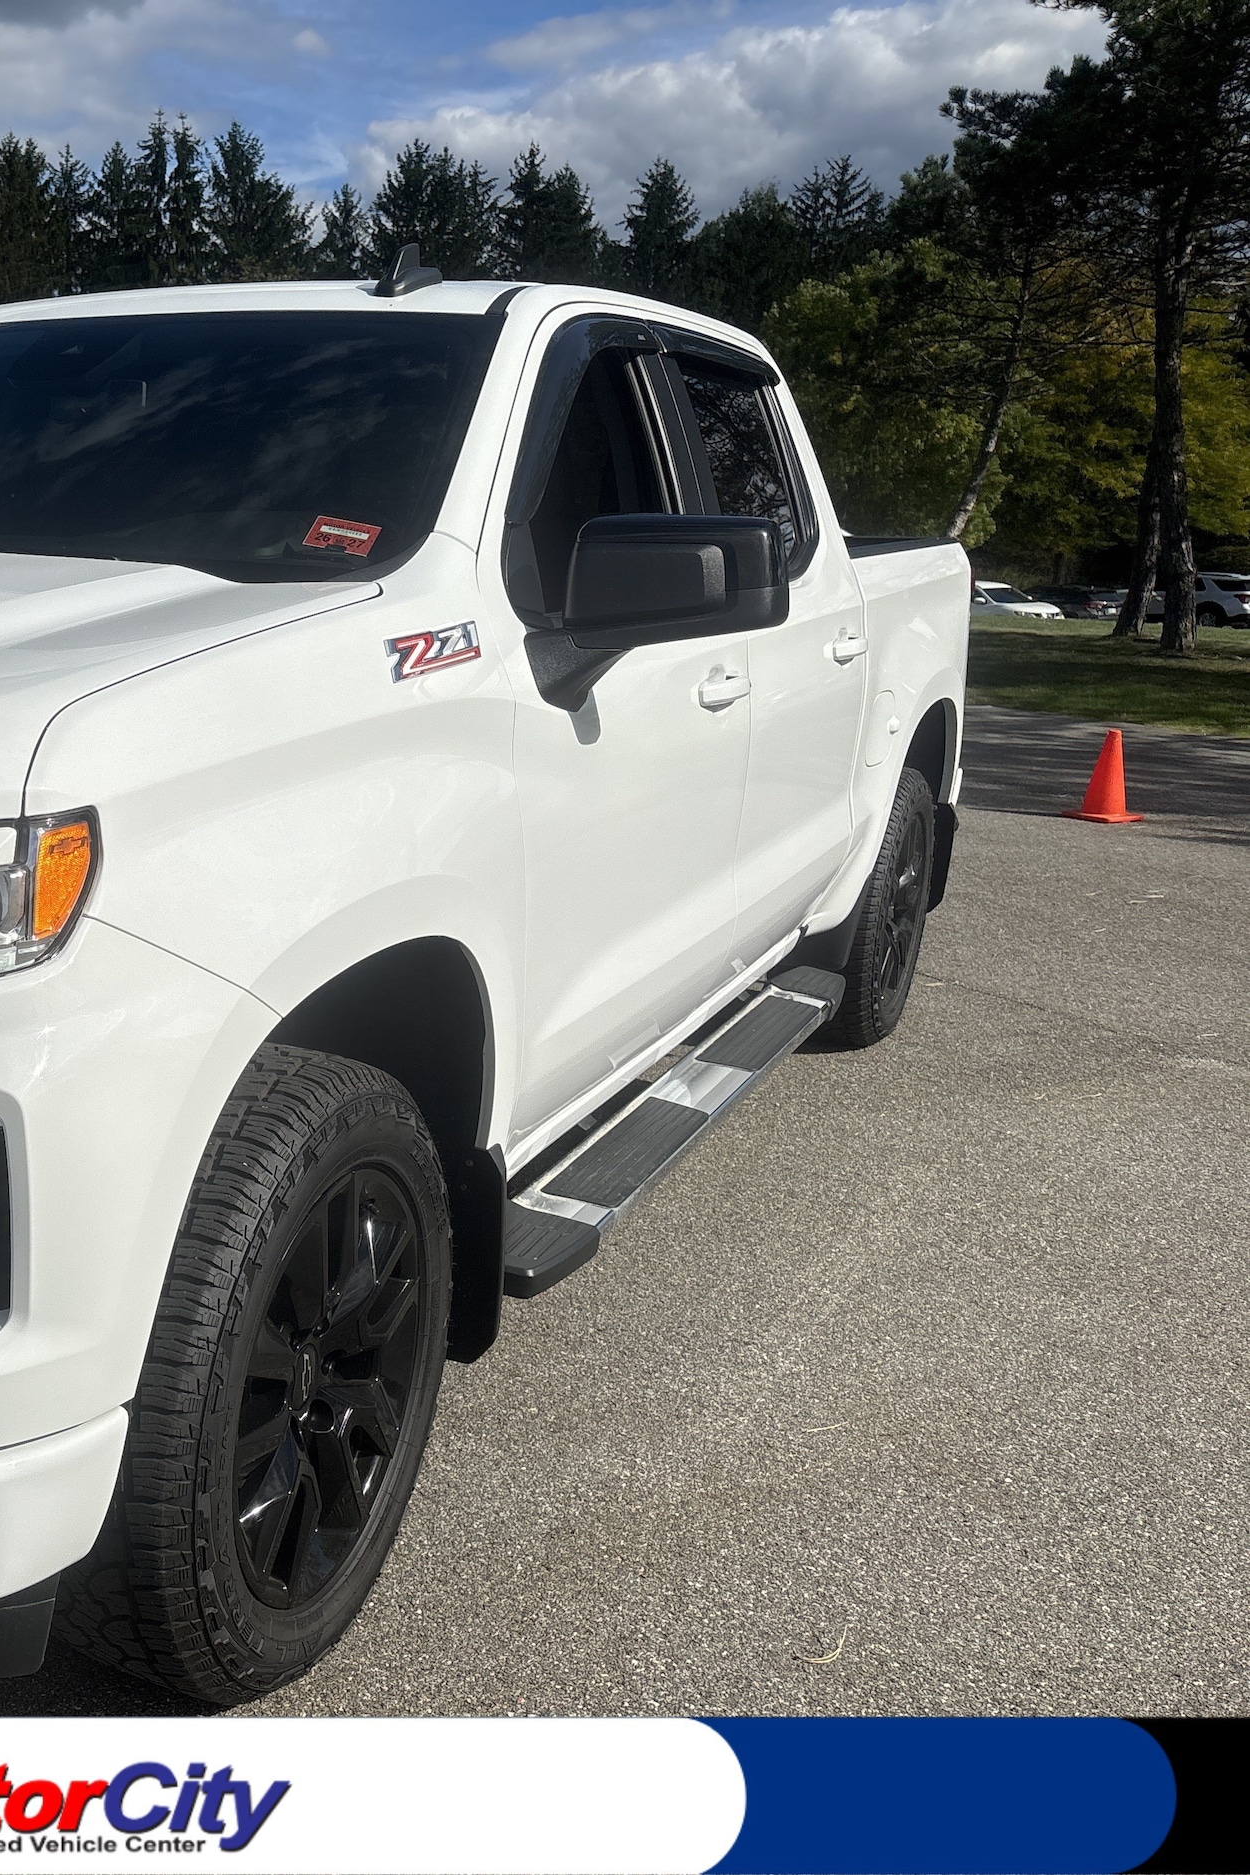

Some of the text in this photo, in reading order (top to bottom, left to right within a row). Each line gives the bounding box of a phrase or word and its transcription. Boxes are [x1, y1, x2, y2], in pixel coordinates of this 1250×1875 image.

[314, 532, 331, 543] 26
[346, 538, 366, 549] 27
[383, 620, 482, 683] Z71
